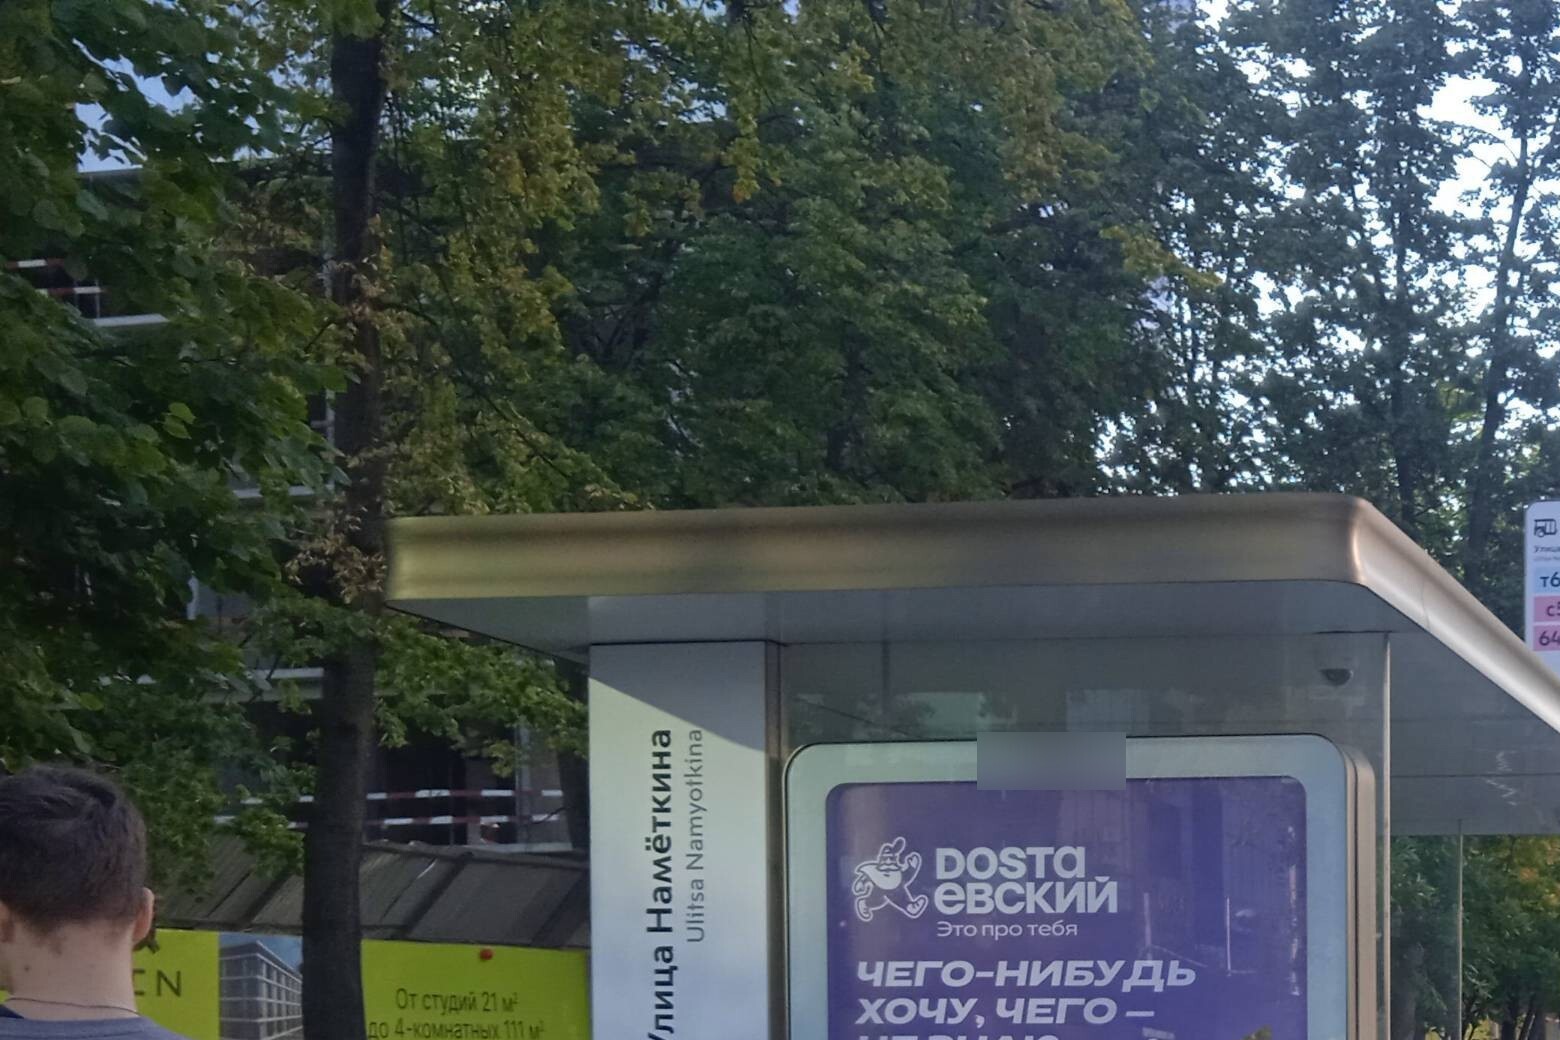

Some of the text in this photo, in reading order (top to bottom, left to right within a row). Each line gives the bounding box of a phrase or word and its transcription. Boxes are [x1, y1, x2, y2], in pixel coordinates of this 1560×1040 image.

[645, 728, 674, 934] Намёткина
[683, 729, 707, 943] Ulitsa Namyotkina
[936, 919, 1079, 941] Это про тебя
[856, 960, 1197, 993] ЧЕГО-НИБУДЬ
[395, 987, 417, 1011] От
[422, 991, 478, 1017] студий
[481, 991, 498, 1012] 21
[855, 998, 985, 1029] ХОЧУ,
[995, 997, 1118, 1025] ЧЕГО
[394, 1017, 500, 1040] 4-комнатных
[503, 1019, 525, 1040] 111
